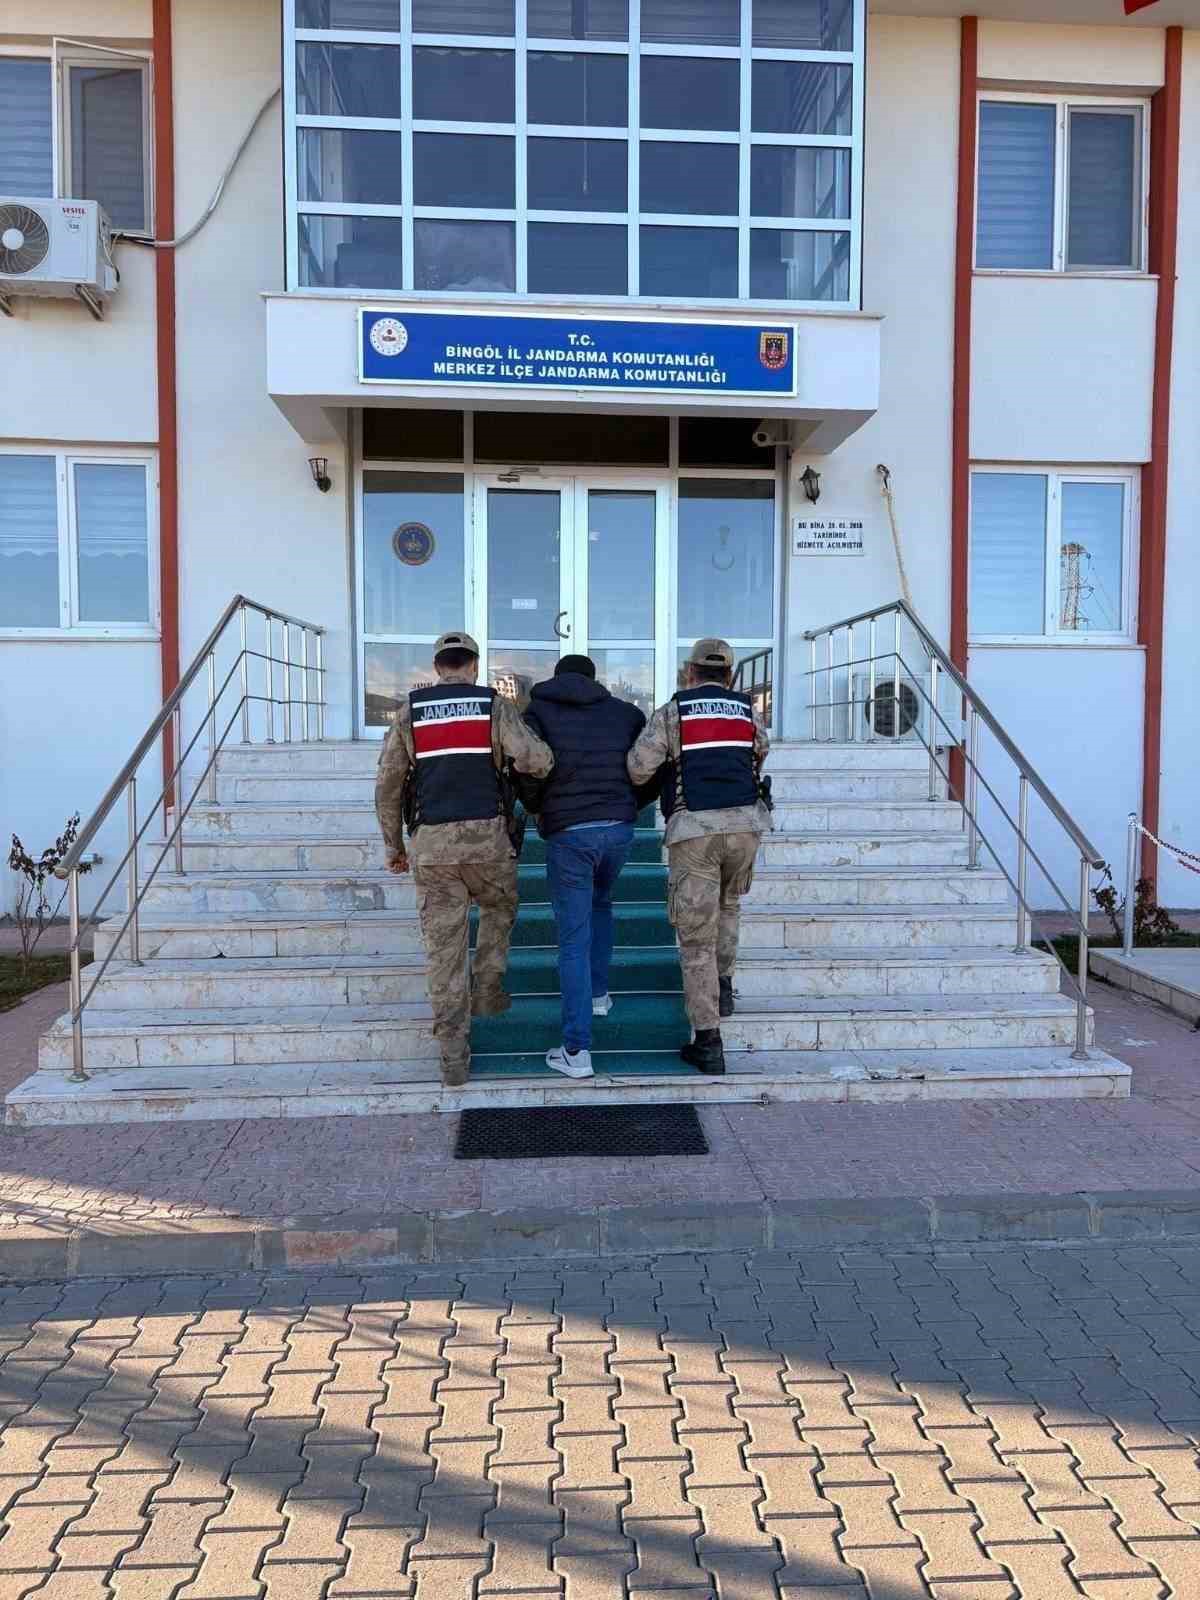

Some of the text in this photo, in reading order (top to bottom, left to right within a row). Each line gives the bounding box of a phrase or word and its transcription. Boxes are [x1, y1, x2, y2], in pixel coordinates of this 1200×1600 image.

[568, 333, 595, 346] T.C.
[446, 343, 715, 367] BİNGÖL İL JANDARMA KOMUTANLIĞI
[433, 361, 727, 383] MERKEZ İLÇE JANDARMA KOMUTANLIĞI
[421, 702, 482, 721] JANDARMA
[688, 703, 745, 716] JANDARMA
